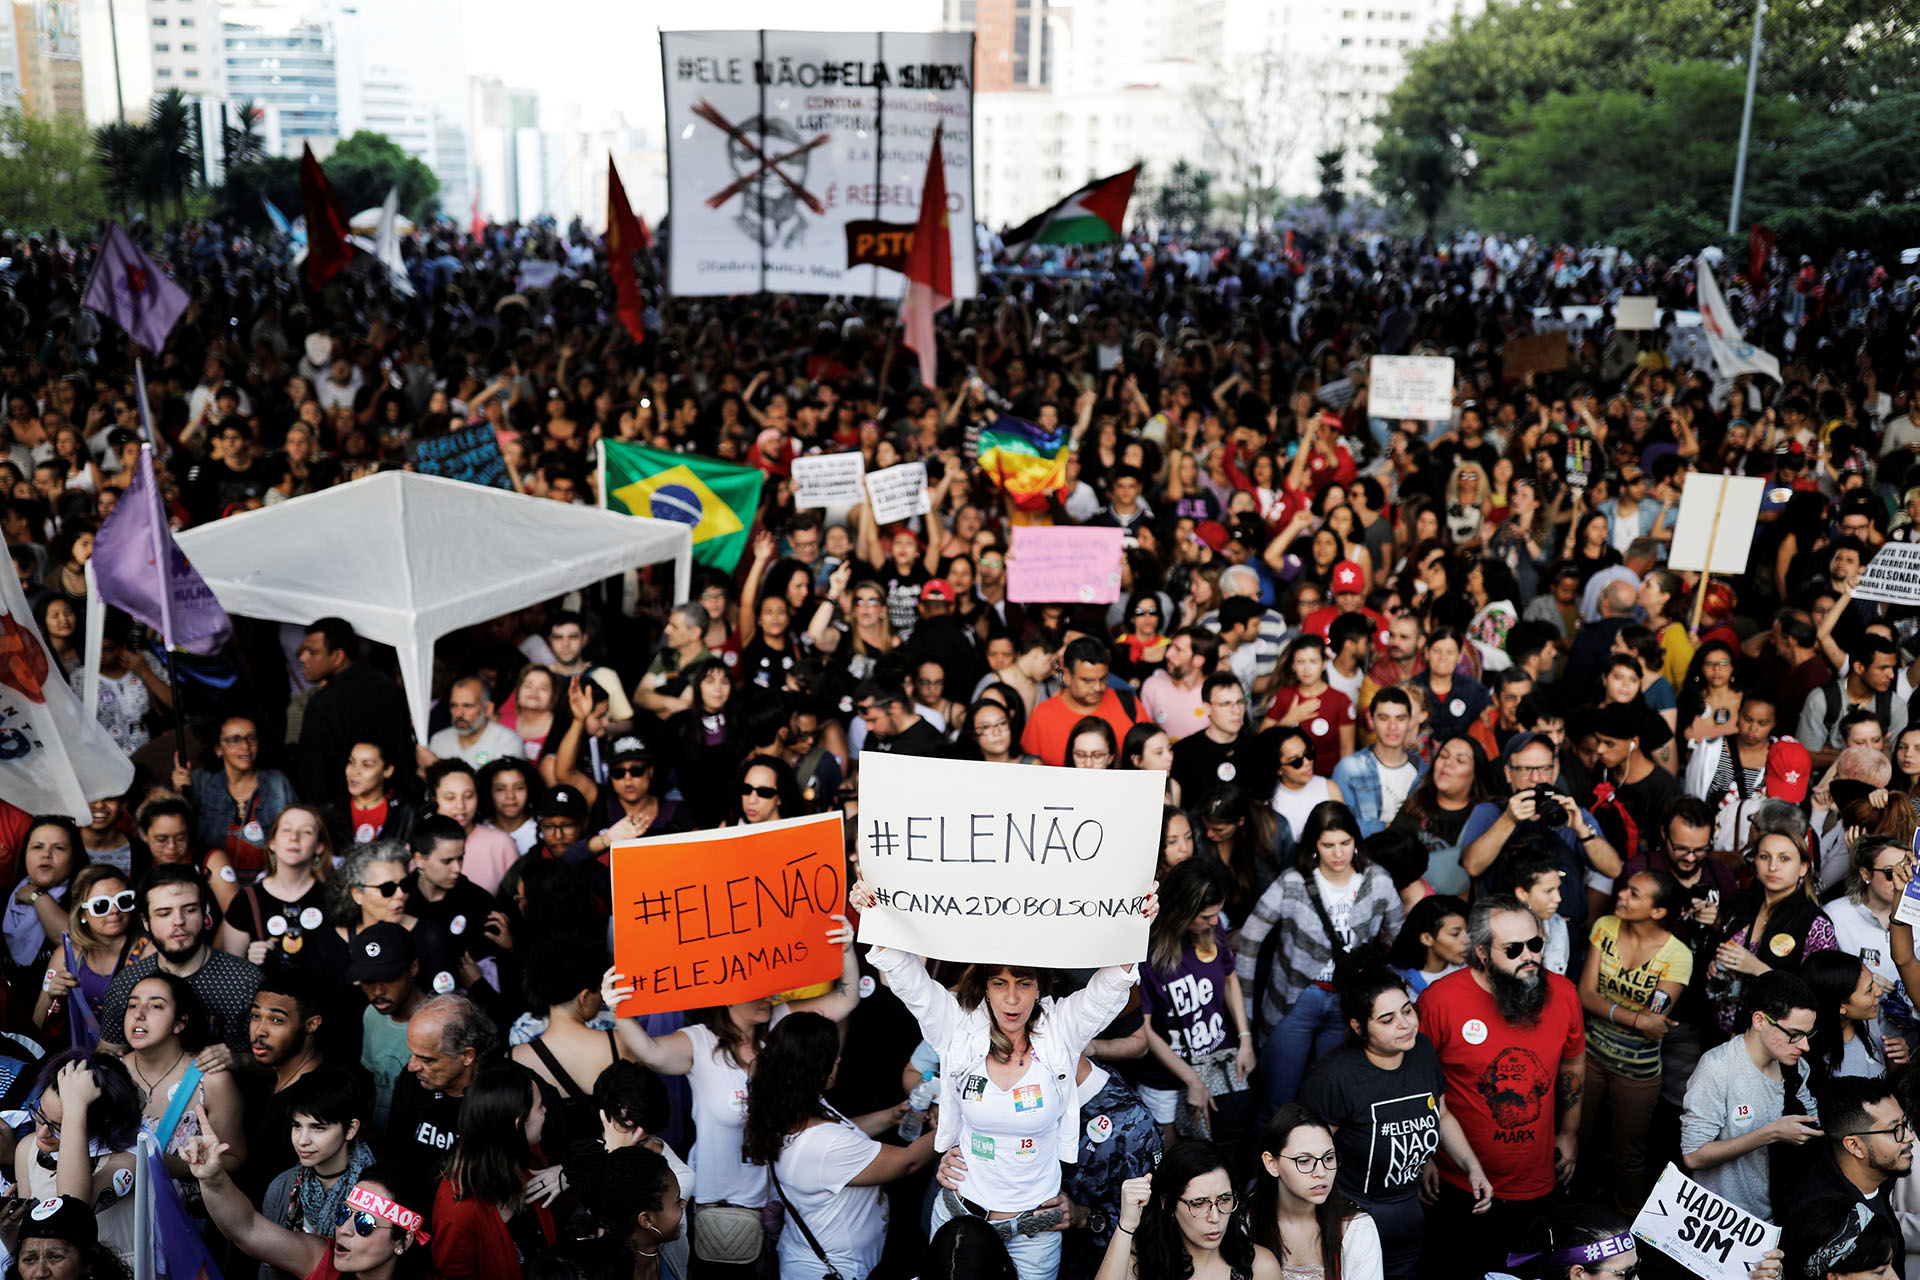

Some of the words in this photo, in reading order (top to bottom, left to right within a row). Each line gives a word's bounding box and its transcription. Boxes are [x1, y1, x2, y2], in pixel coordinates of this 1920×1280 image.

[868, 806, 1103, 864] #ELENÃO
[633, 852, 839, 945] #ELENÃO
[630, 942, 809, 994] #ELEJAMAIS
[1470, 1022, 1481, 1031] 13
[1739, 1105, 1749, 1116] 13
[1098, 1116, 1110, 1130] 13
[1021, 1139, 1033, 1149] 13
[1494, 1129, 1535, 1144] MARX
[123, 1170, 133, 1185] 13
[42, 1199, 57, 1209] 13
[346, 1186, 413, 1227] LENAO
[1676, 1179, 1766, 1247] HADDAD
[1584, 1232, 1636, 1261] #Ele
[1677, 1215, 1735, 1264] SIM
